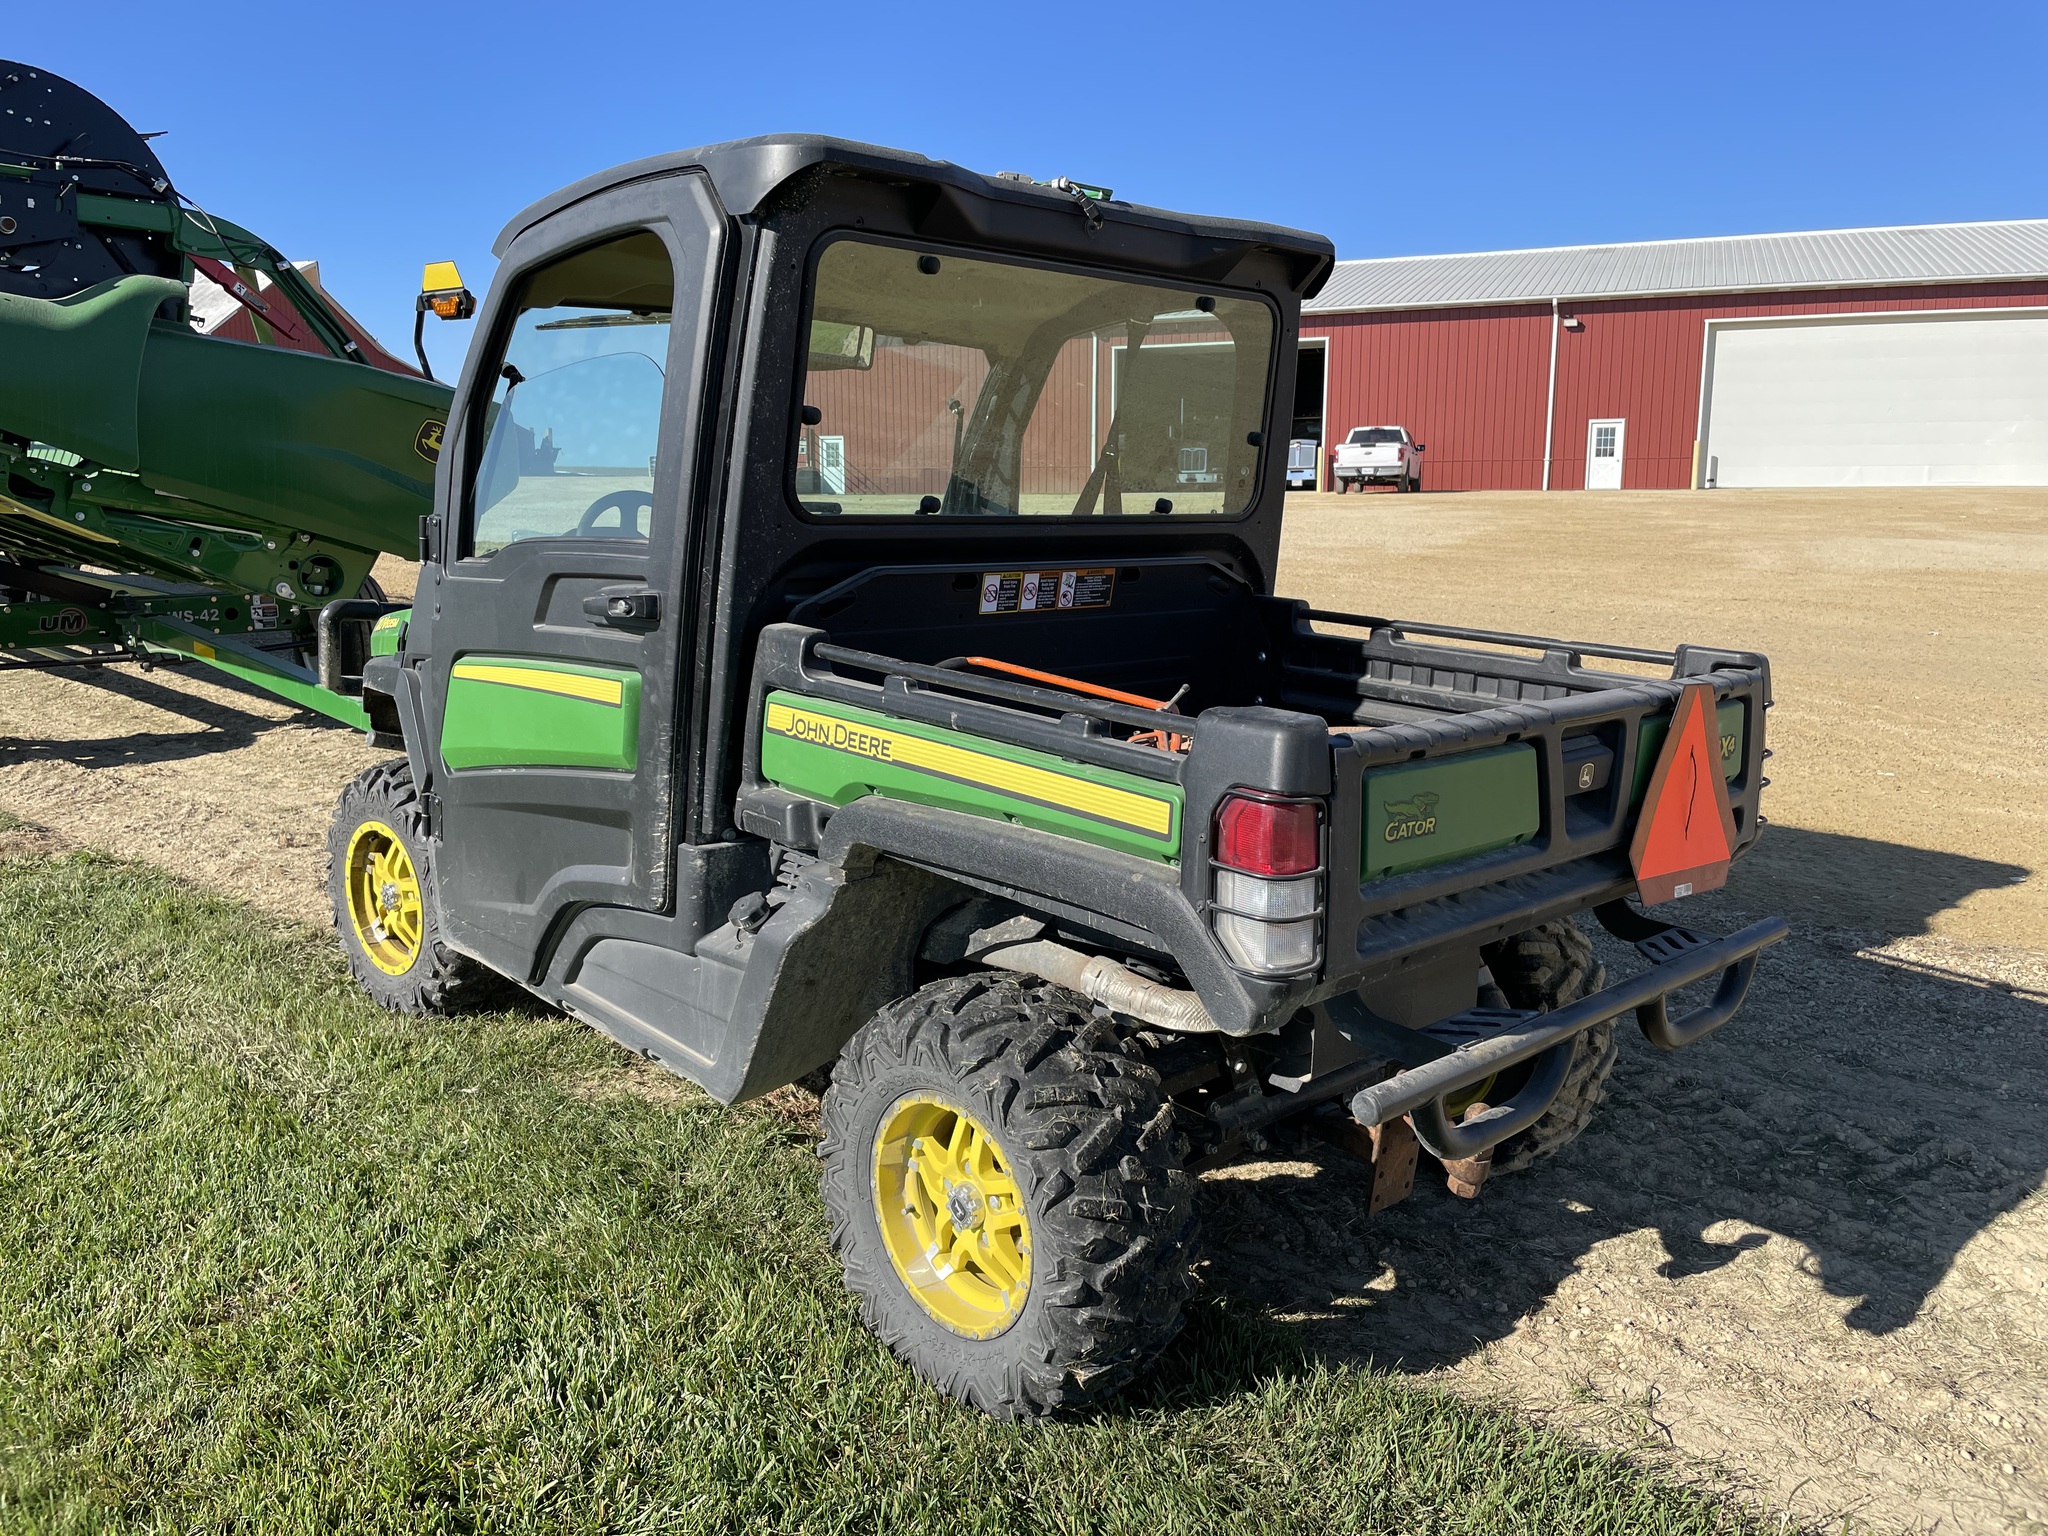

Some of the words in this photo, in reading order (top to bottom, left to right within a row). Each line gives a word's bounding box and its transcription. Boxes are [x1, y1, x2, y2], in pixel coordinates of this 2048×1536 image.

[40, 613, 84, 632] UM
[785, 713, 830, 742] JOHN
[833, 723, 893, 758] DEERE
[1719, 735, 1736, 758] X4
[1384, 817, 1436, 842] GATOR
